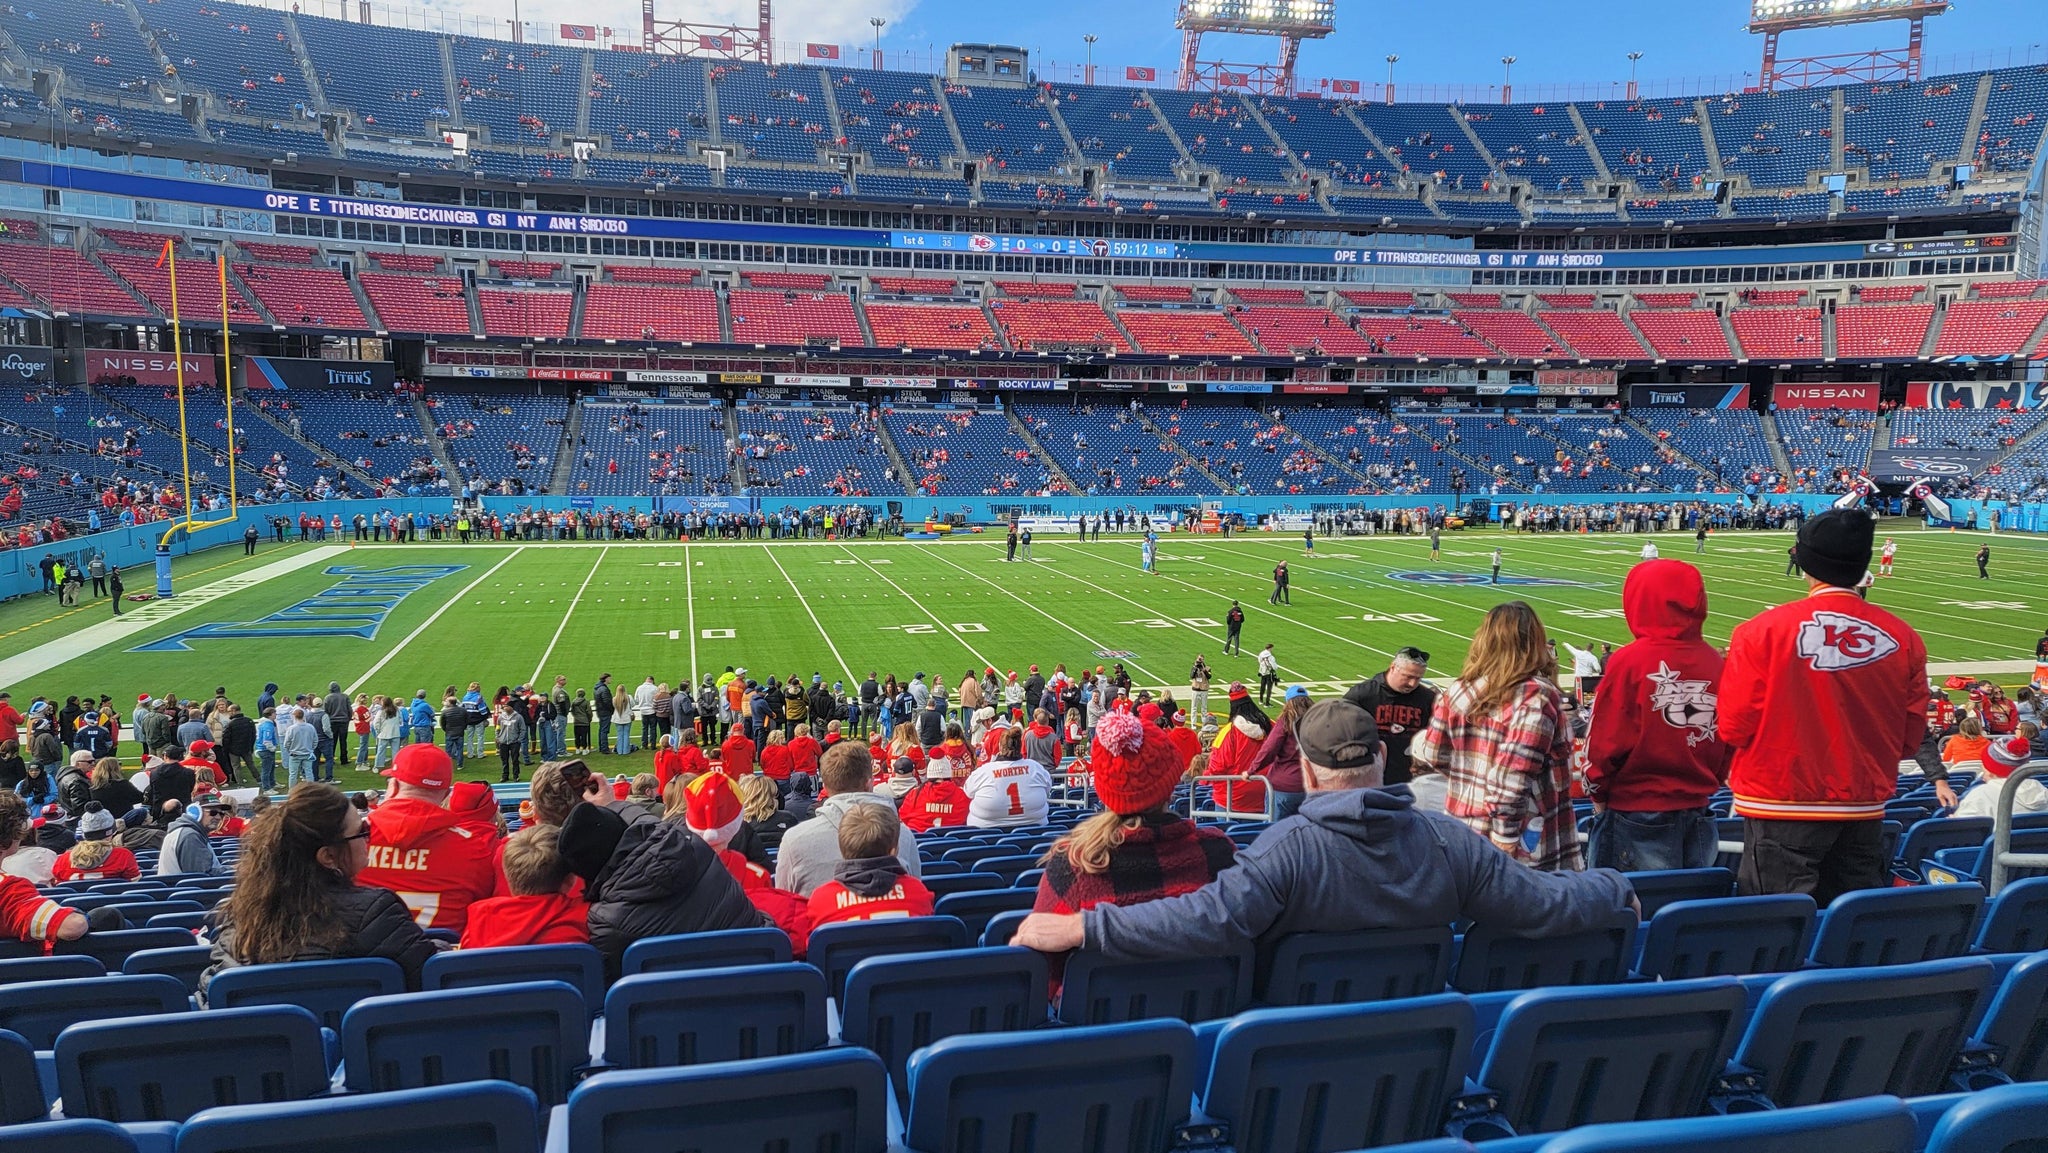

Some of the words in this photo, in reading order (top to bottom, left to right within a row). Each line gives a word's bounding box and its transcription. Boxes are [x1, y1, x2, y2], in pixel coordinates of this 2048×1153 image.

[903, 236, 917, 245] 1st
[1017, 239, 1026, 251] 0
[1052, 240, 1061, 252] 0
[1114, 242, 1148, 255] 59:12
[1154, 245, 1167, 255] 1st
[1, 353, 47, 378] Kroger
[104, 357, 200, 373] NISSAN
[324, 368, 372, 385] TITANS
[999, 380, 1029, 388] ROCKY
[1031, 381, 1051, 389] LAW
[1228, 384, 1264, 392] Gallagher
[669, 391, 712, 399] MATTHEWS
[1649, 391, 1686, 404] TITANS
[1787, 388, 1866, 398] NISSAN
[1823, 624, 1876, 658] KC
[1375, 704, 1423, 728] CHIEFS
[992, 765, 1030, 779] WORTHY
[1006, 782, 1025, 816] 1
[925, 802, 954, 814] WORTHY
[367, 845, 430, 871] KELCE
